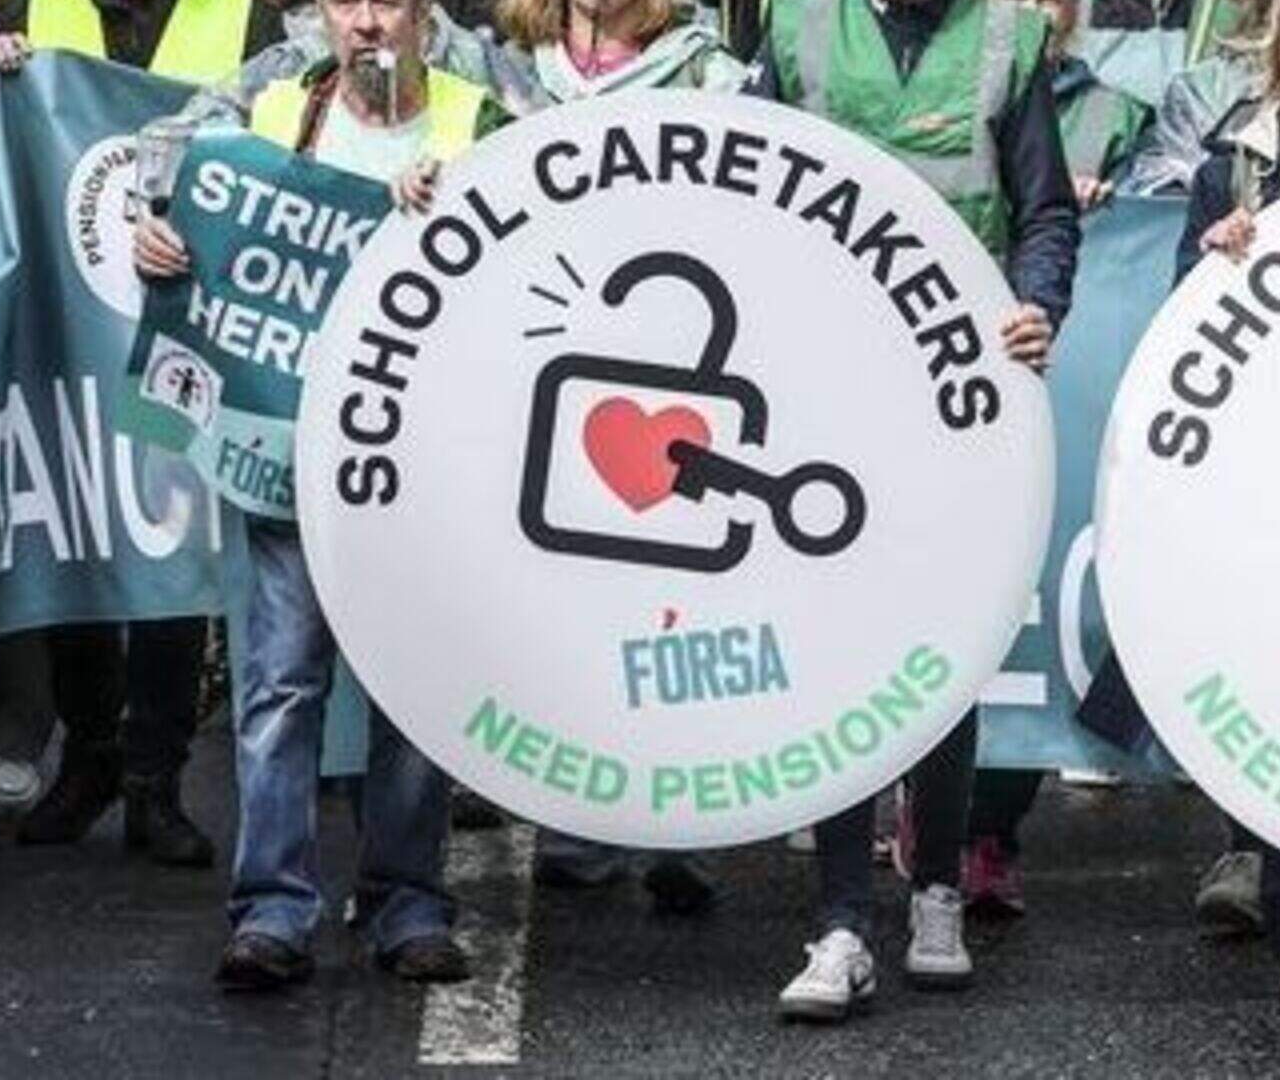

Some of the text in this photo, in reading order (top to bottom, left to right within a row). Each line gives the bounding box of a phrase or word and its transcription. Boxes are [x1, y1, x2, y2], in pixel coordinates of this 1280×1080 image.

[190, 159, 376, 262] STRIK
[231, 247, 328, 314] ON
[337, 124, 1001, 507] SCHOOL CARETAKERS
[216, 436, 294, 507] FÓRS
[621, 608, 790, 709] FÓRSA
[463, 640, 952, 815] NEED PENSIONS
